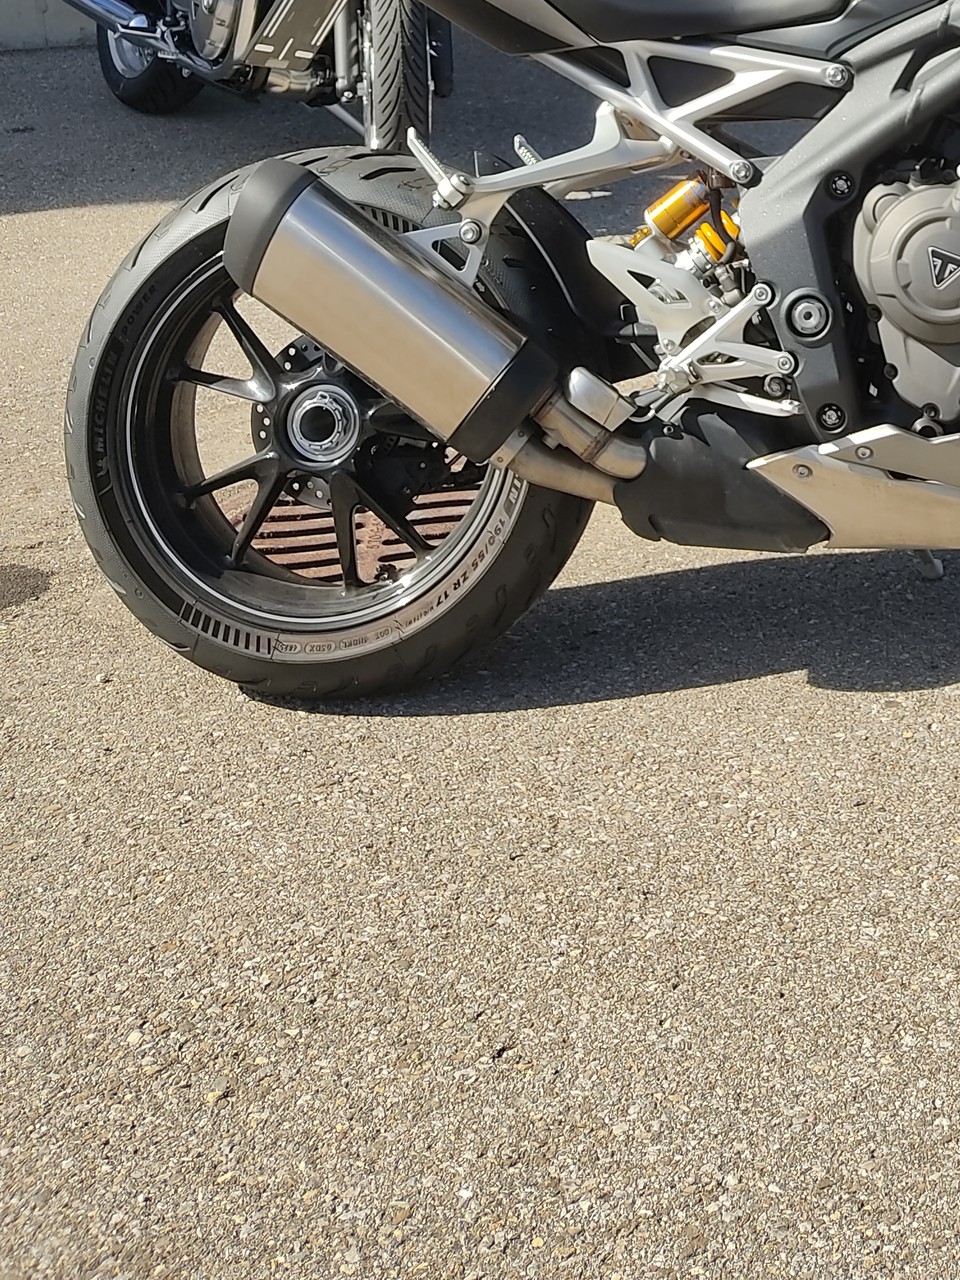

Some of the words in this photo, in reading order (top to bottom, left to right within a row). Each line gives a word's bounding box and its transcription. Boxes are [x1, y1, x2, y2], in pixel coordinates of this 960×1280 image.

[94, 351, 118, 452] MICHELIN
[122, 286, 156, 335] POWER
[471, 518, 505, 572] 190/55
[436, 591, 450, 608] 17
[453, 571, 469, 591] ZR
